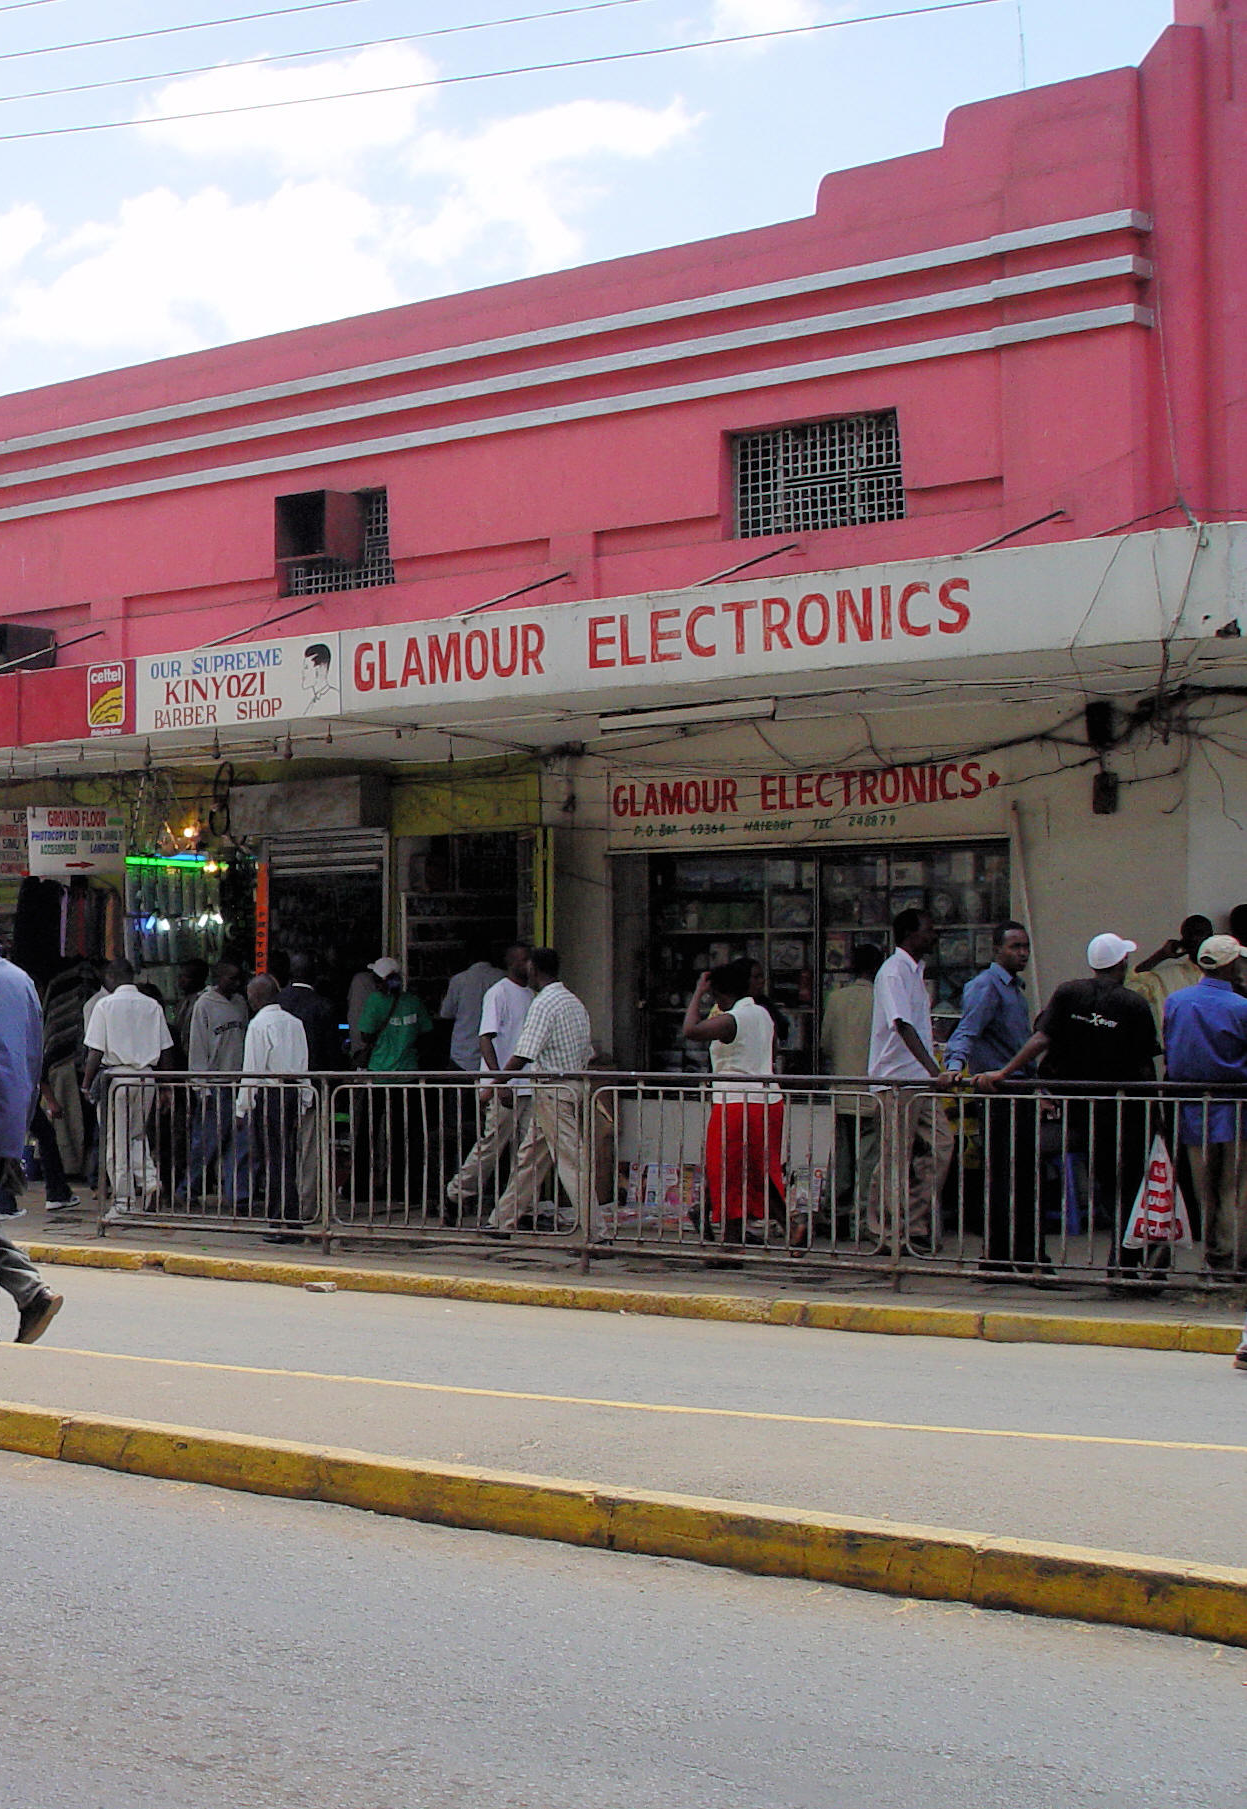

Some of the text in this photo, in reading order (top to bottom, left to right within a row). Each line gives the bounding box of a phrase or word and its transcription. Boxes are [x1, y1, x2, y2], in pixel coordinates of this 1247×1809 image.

[354, 577, 971, 692] GLAMOUR ELECTRONICS
[90, 666, 122, 684] celtel
[150, 648, 282, 680] OUR SUPREEME
[165, 671, 266, 706] KINYOZI
[154, 698, 282, 730] BARBER SHOP
[612, 762, 982, 818] GLAMOUR ELECTRONICS
[47, 810, 107, 828] GROUND FLOOR
